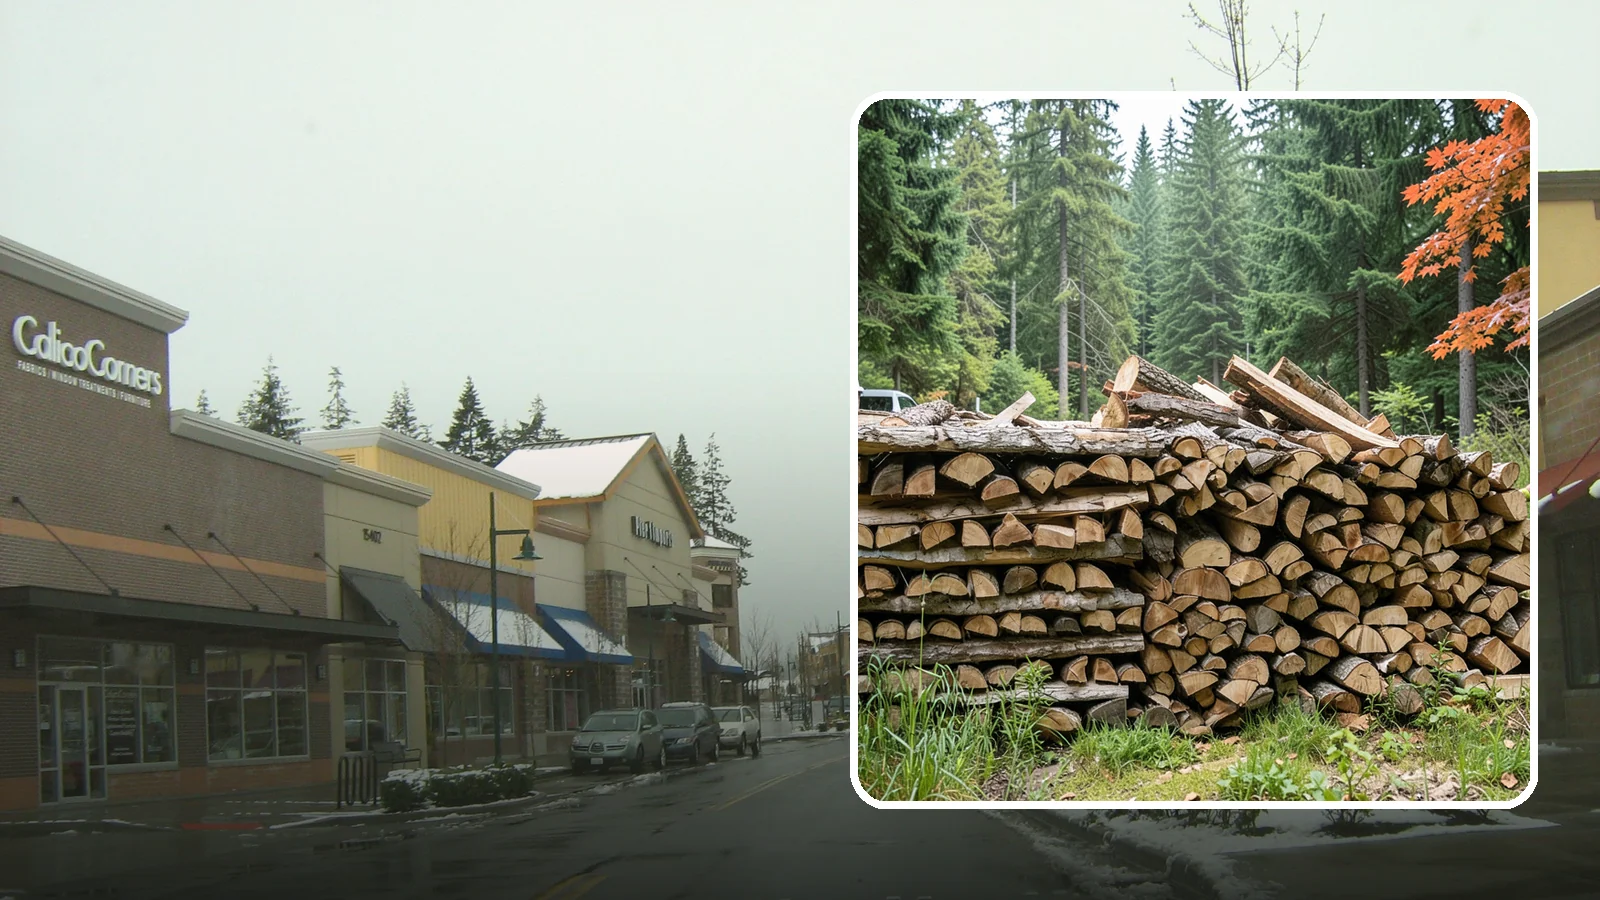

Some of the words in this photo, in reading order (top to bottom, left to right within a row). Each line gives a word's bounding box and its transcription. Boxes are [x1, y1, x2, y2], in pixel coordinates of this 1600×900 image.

[17, 359, 47, 378] FABRICS
[52, 370, 78, 387] WINDOW
[79, 378, 117, 398] TREATMENTS
[121, 391, 151, 408] FURNITURE
